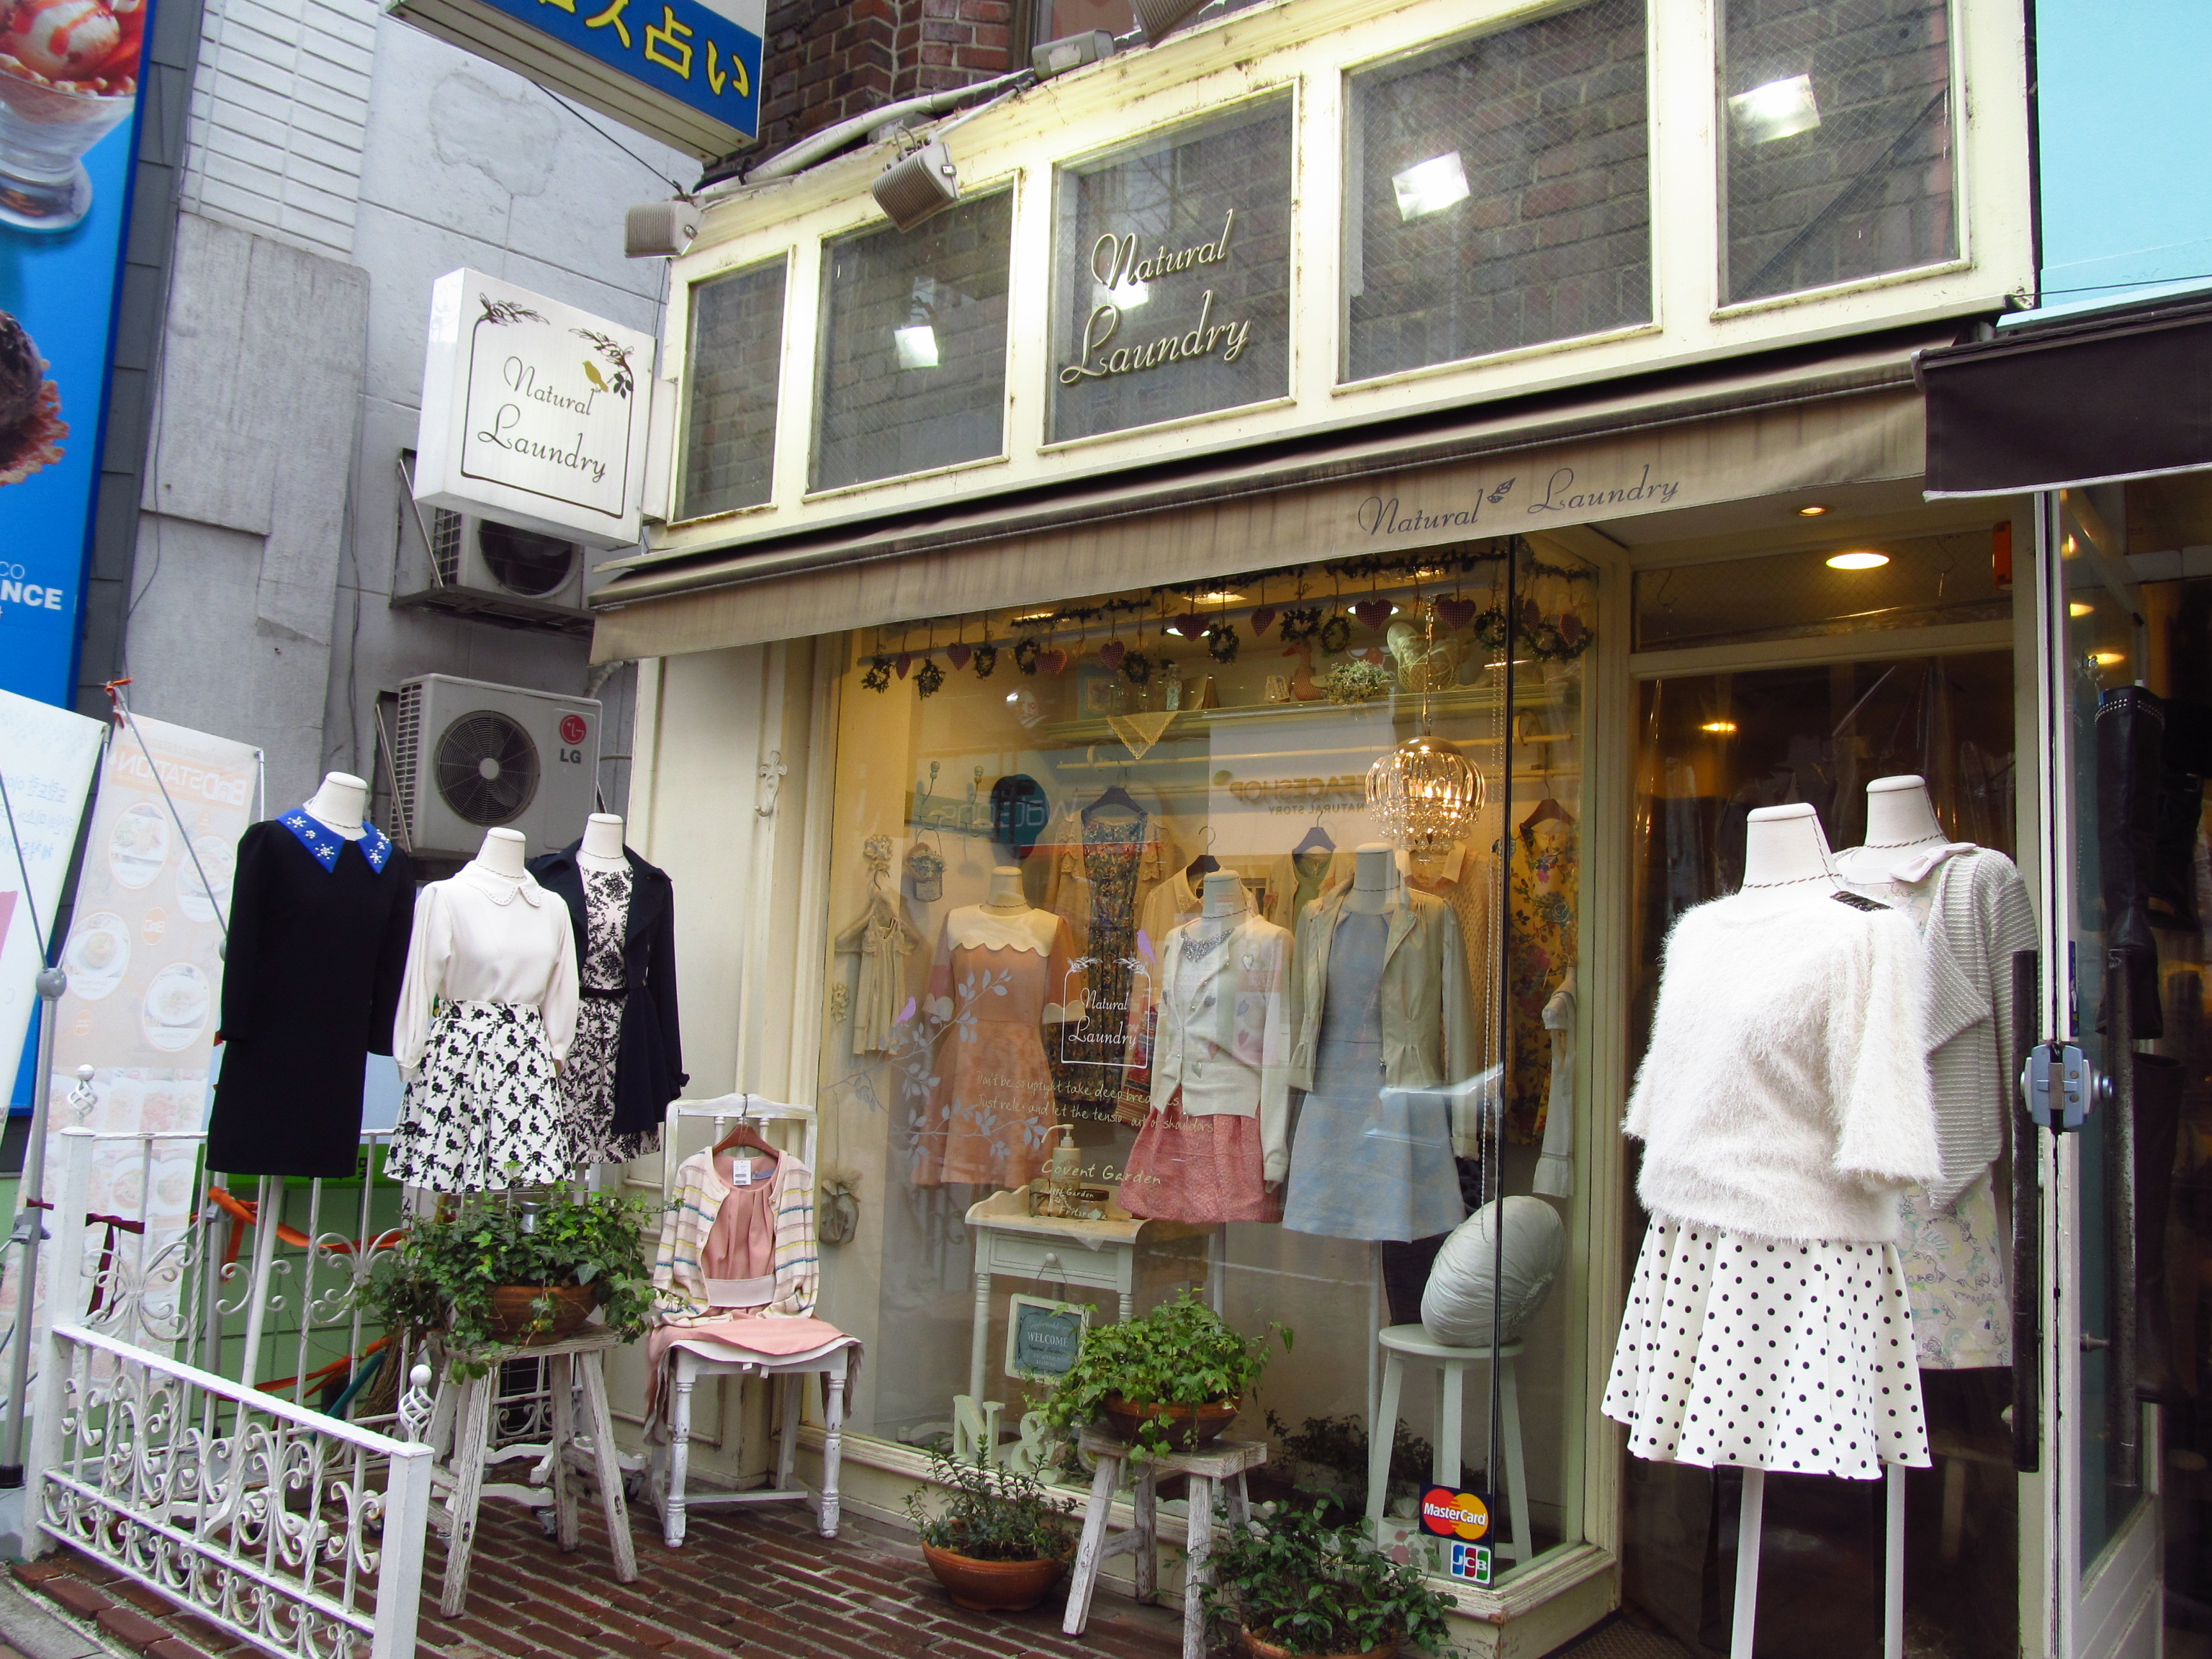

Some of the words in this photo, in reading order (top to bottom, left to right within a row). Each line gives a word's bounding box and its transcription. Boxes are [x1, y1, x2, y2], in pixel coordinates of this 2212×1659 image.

[1091, 207, 1233, 290] Natural
[1060, 289, 1251, 384] Laundry
[503, 356, 596, 415] Natural
[477, 403, 606, 483] Laundry
[1358, 489, 1484, 536] Natural
[1527, 464, 1680, 514] Laundry
[1, 579, 63, 611] NCE
[559, 748, 582, 764] LG
[1080, 987, 1129, 1010] Natural
[1068, 1015, 1137, 1050] Laundry
[976, 1071, 998, 1086] Don't
[1001, 1075, 1012, 1087] be
[1015, 1079, 1025, 1089] so
[1027, 1078, 1062, 1099] uptight
[1065, 1082, 1092, 1096] take
[1094, 1084, 1123, 1105] deep
[975, 1094, 998, 1109] Just
[1028, 1101, 1050, 1116] and
[1052, 1102, 1067, 1117] let
[1070, 1104, 1089, 1120] the
[1041, 1159, 1095, 1177] Covent
[1102, 1164, 1161, 1184] Garden
[1066, 1188, 1094, 1198] Garden
[1028, 1331, 1069, 1346] WELCOME
[1424, 1502, 1486, 1526] MasterCard
[1452, 1555, 1488, 1571] JCB
